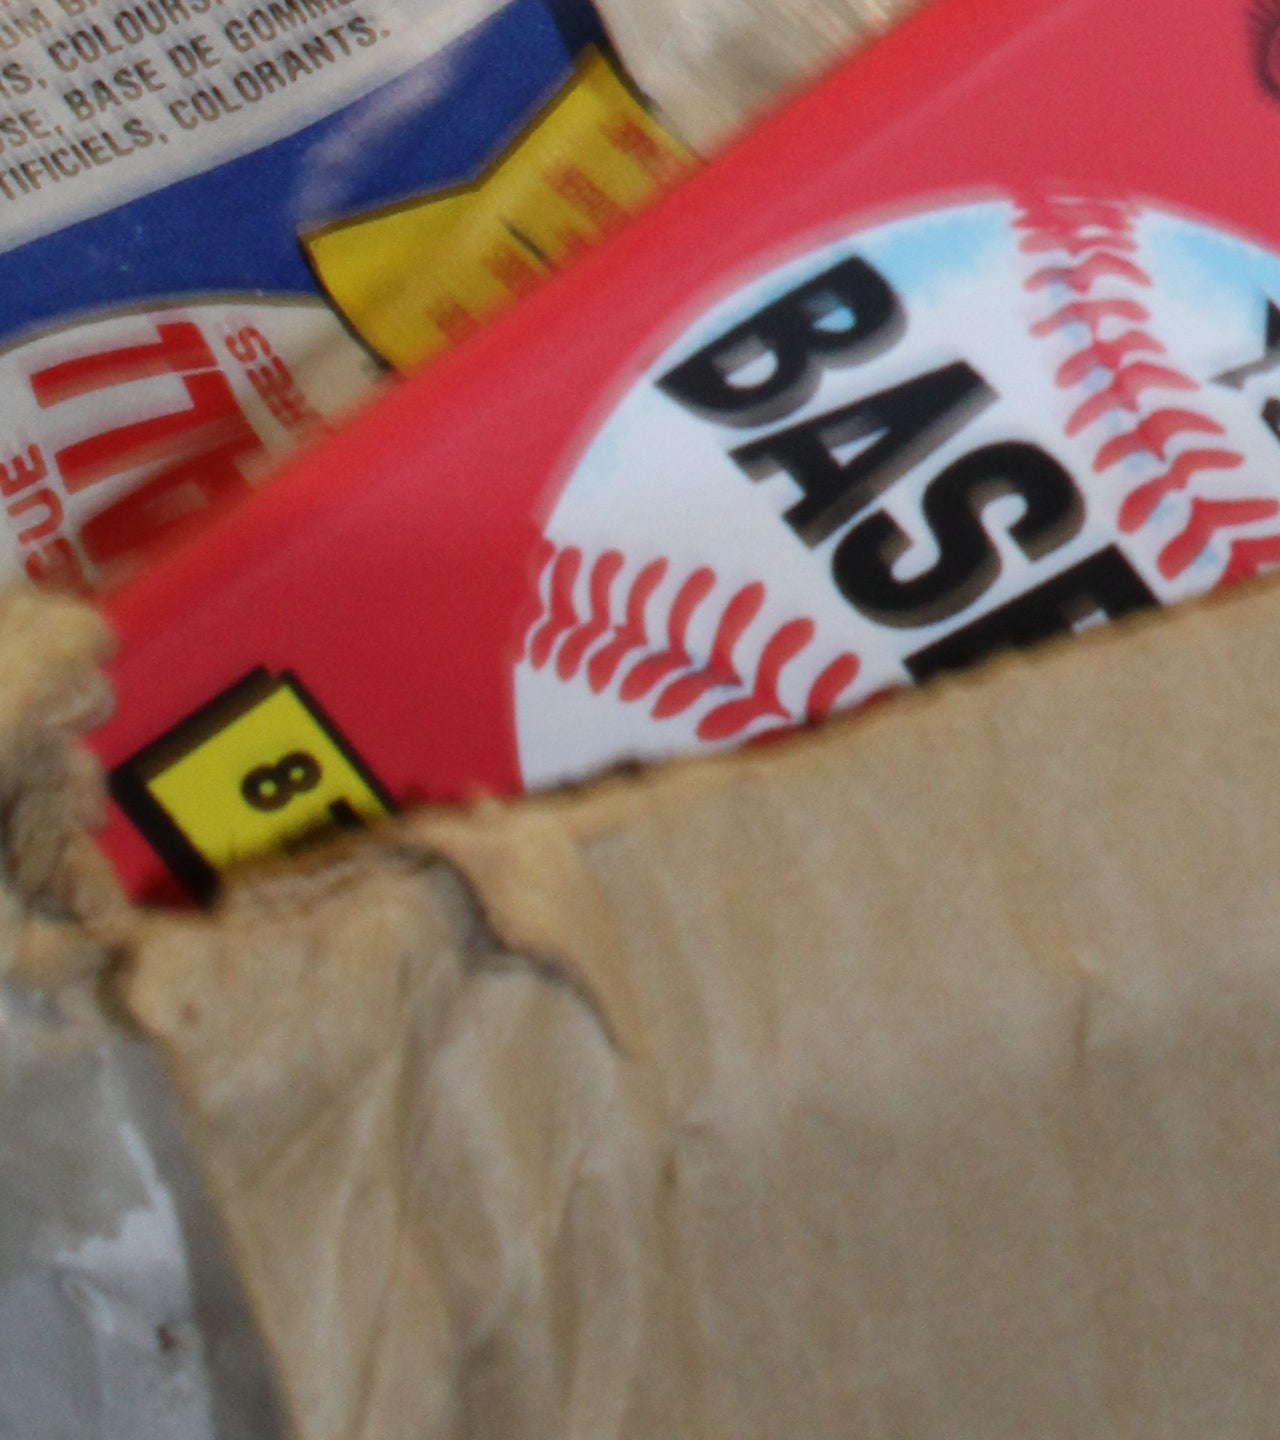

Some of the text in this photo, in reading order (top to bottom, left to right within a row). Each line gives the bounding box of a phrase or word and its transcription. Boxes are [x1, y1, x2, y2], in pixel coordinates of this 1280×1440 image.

[62, 57, 168, 123] BASE
[167, 33, 222, 80] DE
[168, 13, 393, 132] COLORANTS.
[240, 748, 324, 813] 8
